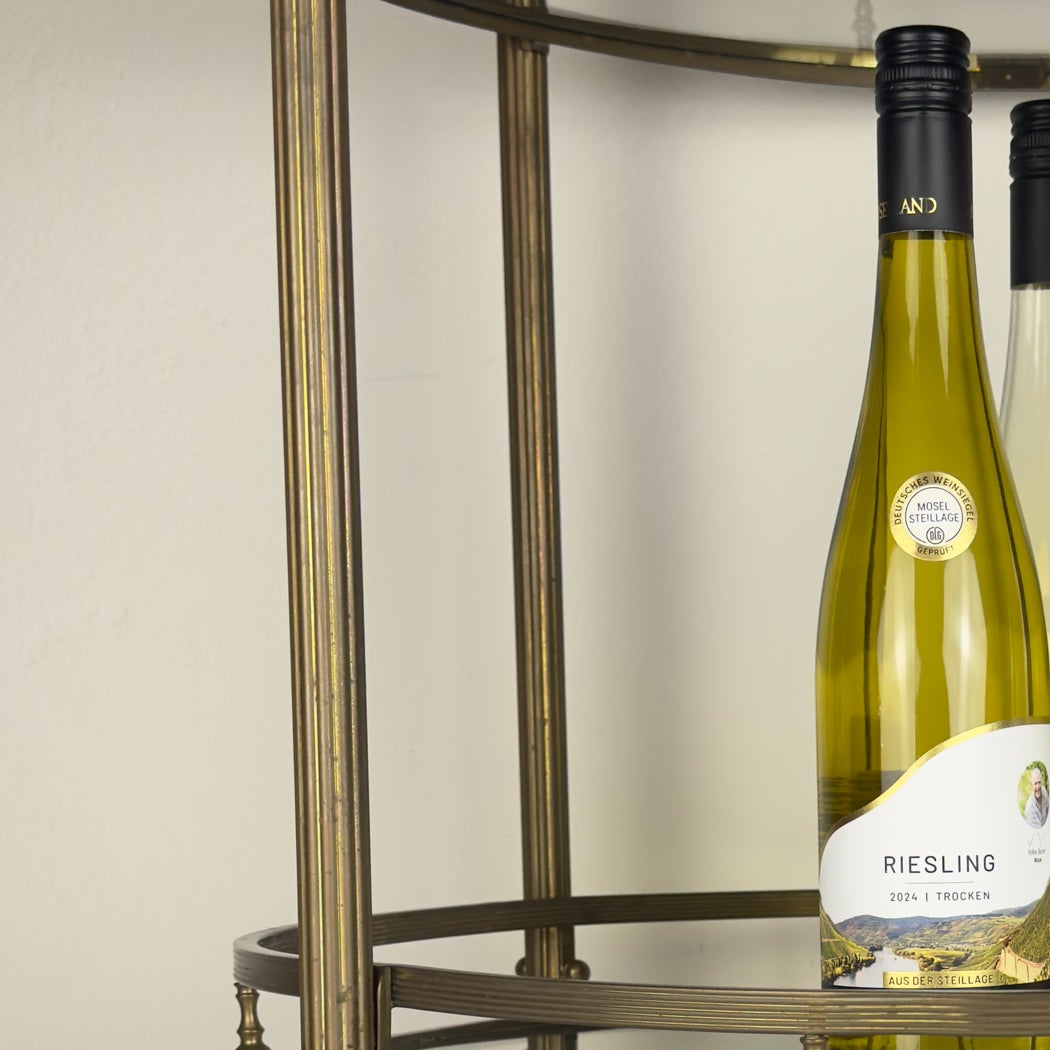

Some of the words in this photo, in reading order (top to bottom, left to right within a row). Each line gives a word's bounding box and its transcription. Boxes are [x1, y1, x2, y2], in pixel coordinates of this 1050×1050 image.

[894, 476, 929, 525] DEUTSCHES
[933, 476, 974, 522] WEINSIEGEL
[917, 501, 950, 511] MOSEL
[909, 513, 959, 523] STEILLAGE
[884, 854, 995, 873] RIESLING
[890, 892, 918, 902] 2024
[936, 891, 990, 901] TROCKEN
[888, 976, 909, 985] AUS
[912, 976, 934, 985] DER
[936, 974, 994, 985] STEILLAGE
